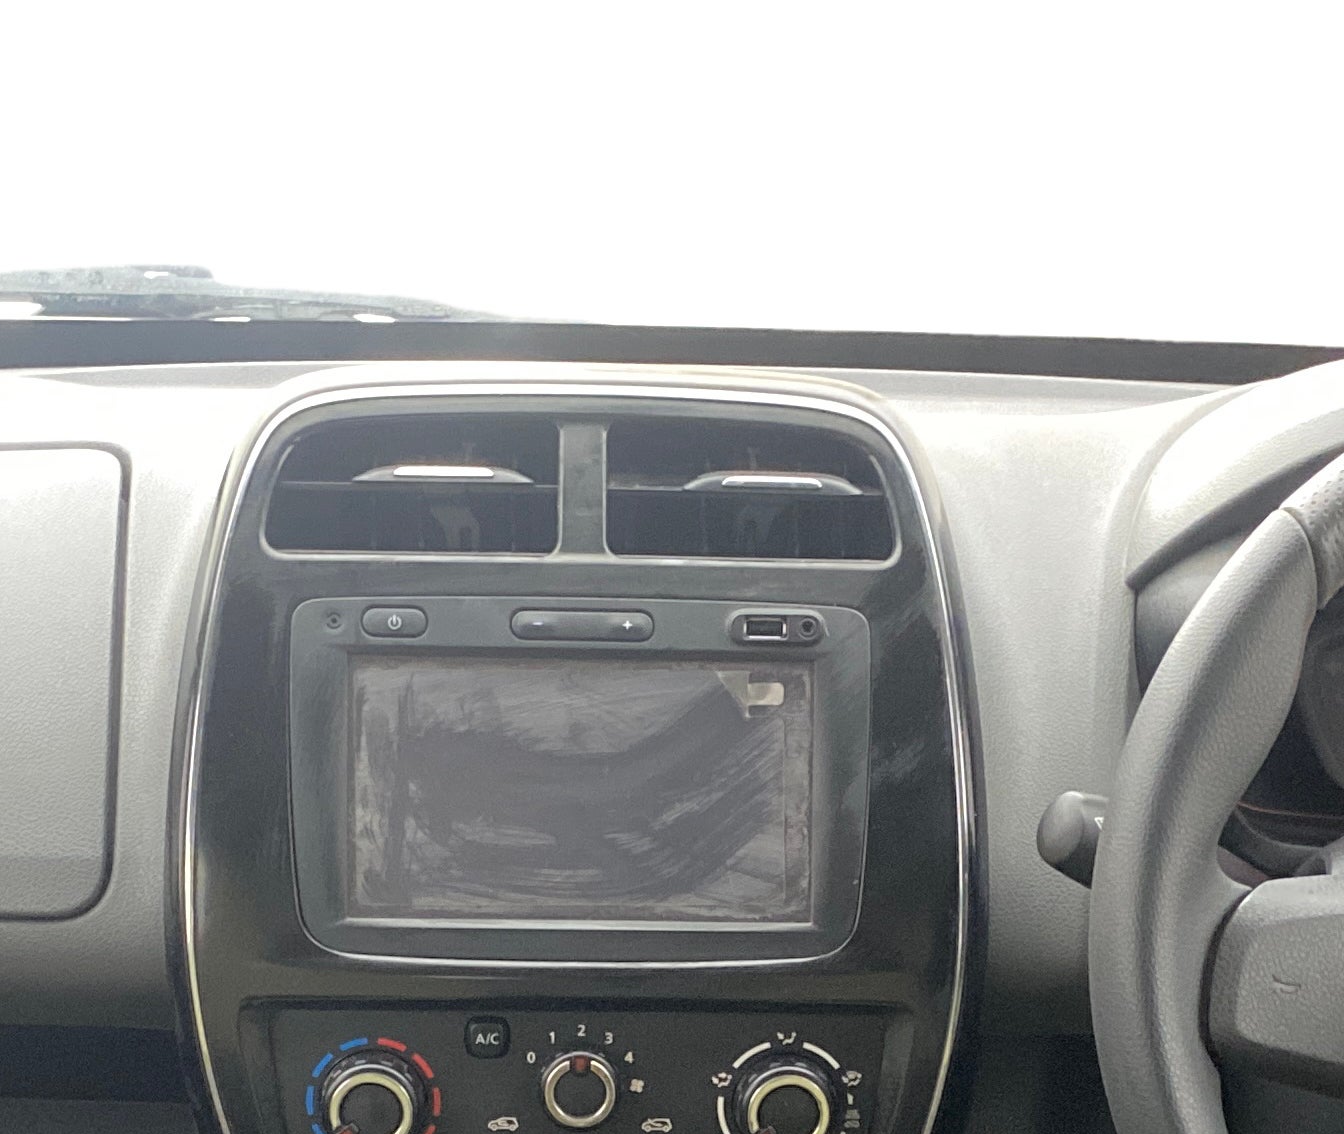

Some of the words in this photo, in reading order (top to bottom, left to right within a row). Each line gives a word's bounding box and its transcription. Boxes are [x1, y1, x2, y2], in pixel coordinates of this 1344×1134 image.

[475, 1032, 500, 1045] A/C
[526, 1051, 536, 1064] 0
[549, 1031, 555, 1044] 1
[577, 1024, 586, 1037] 2
[604, 1032, 613, 1045] 3
[624, 1051, 634, 1064] 4
